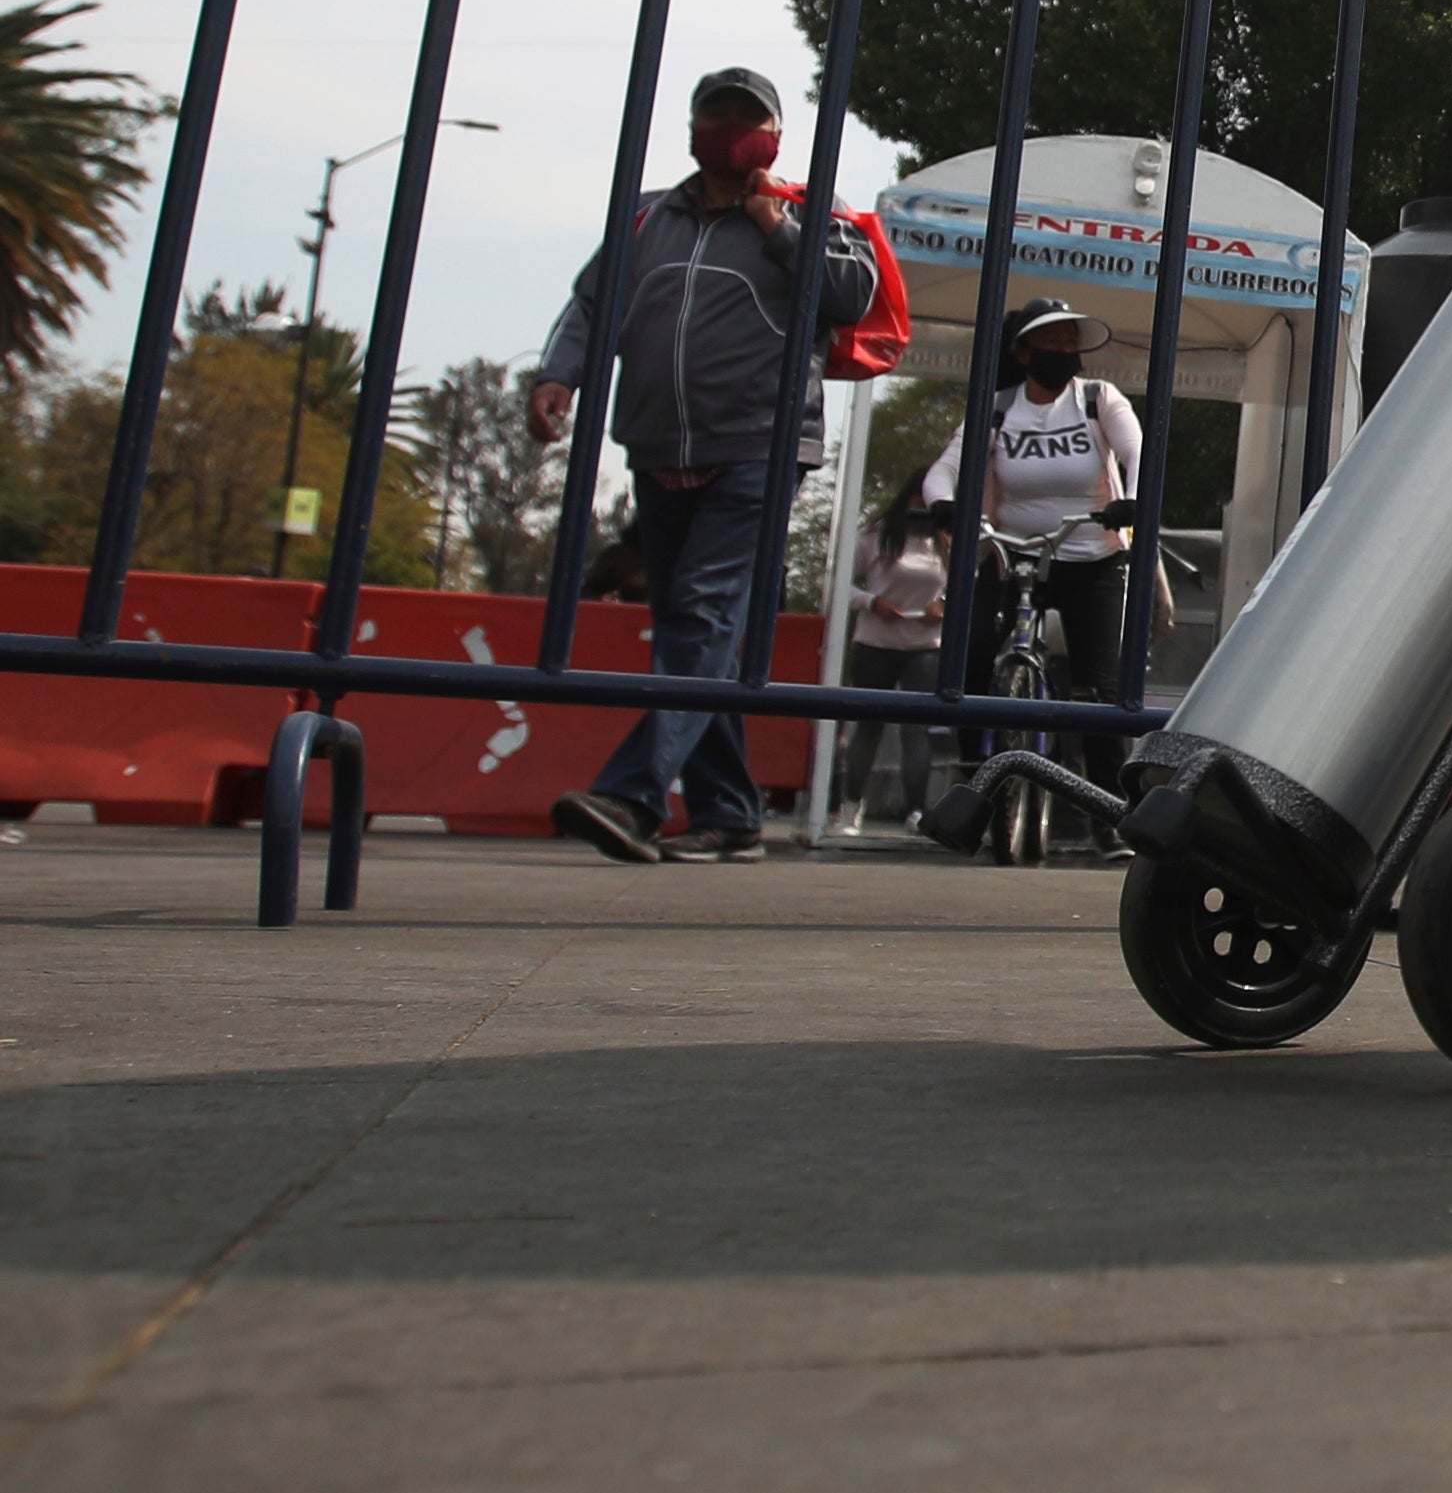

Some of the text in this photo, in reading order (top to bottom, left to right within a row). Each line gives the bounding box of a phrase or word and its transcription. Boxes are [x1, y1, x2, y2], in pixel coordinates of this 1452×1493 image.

[889, 227, 945, 250] USO
[954, 235, 1135, 275] OBIGATORIO
[1187, 265, 1353, 302] CUBREBOCS
[1001, 423, 1091, 459] VANS
